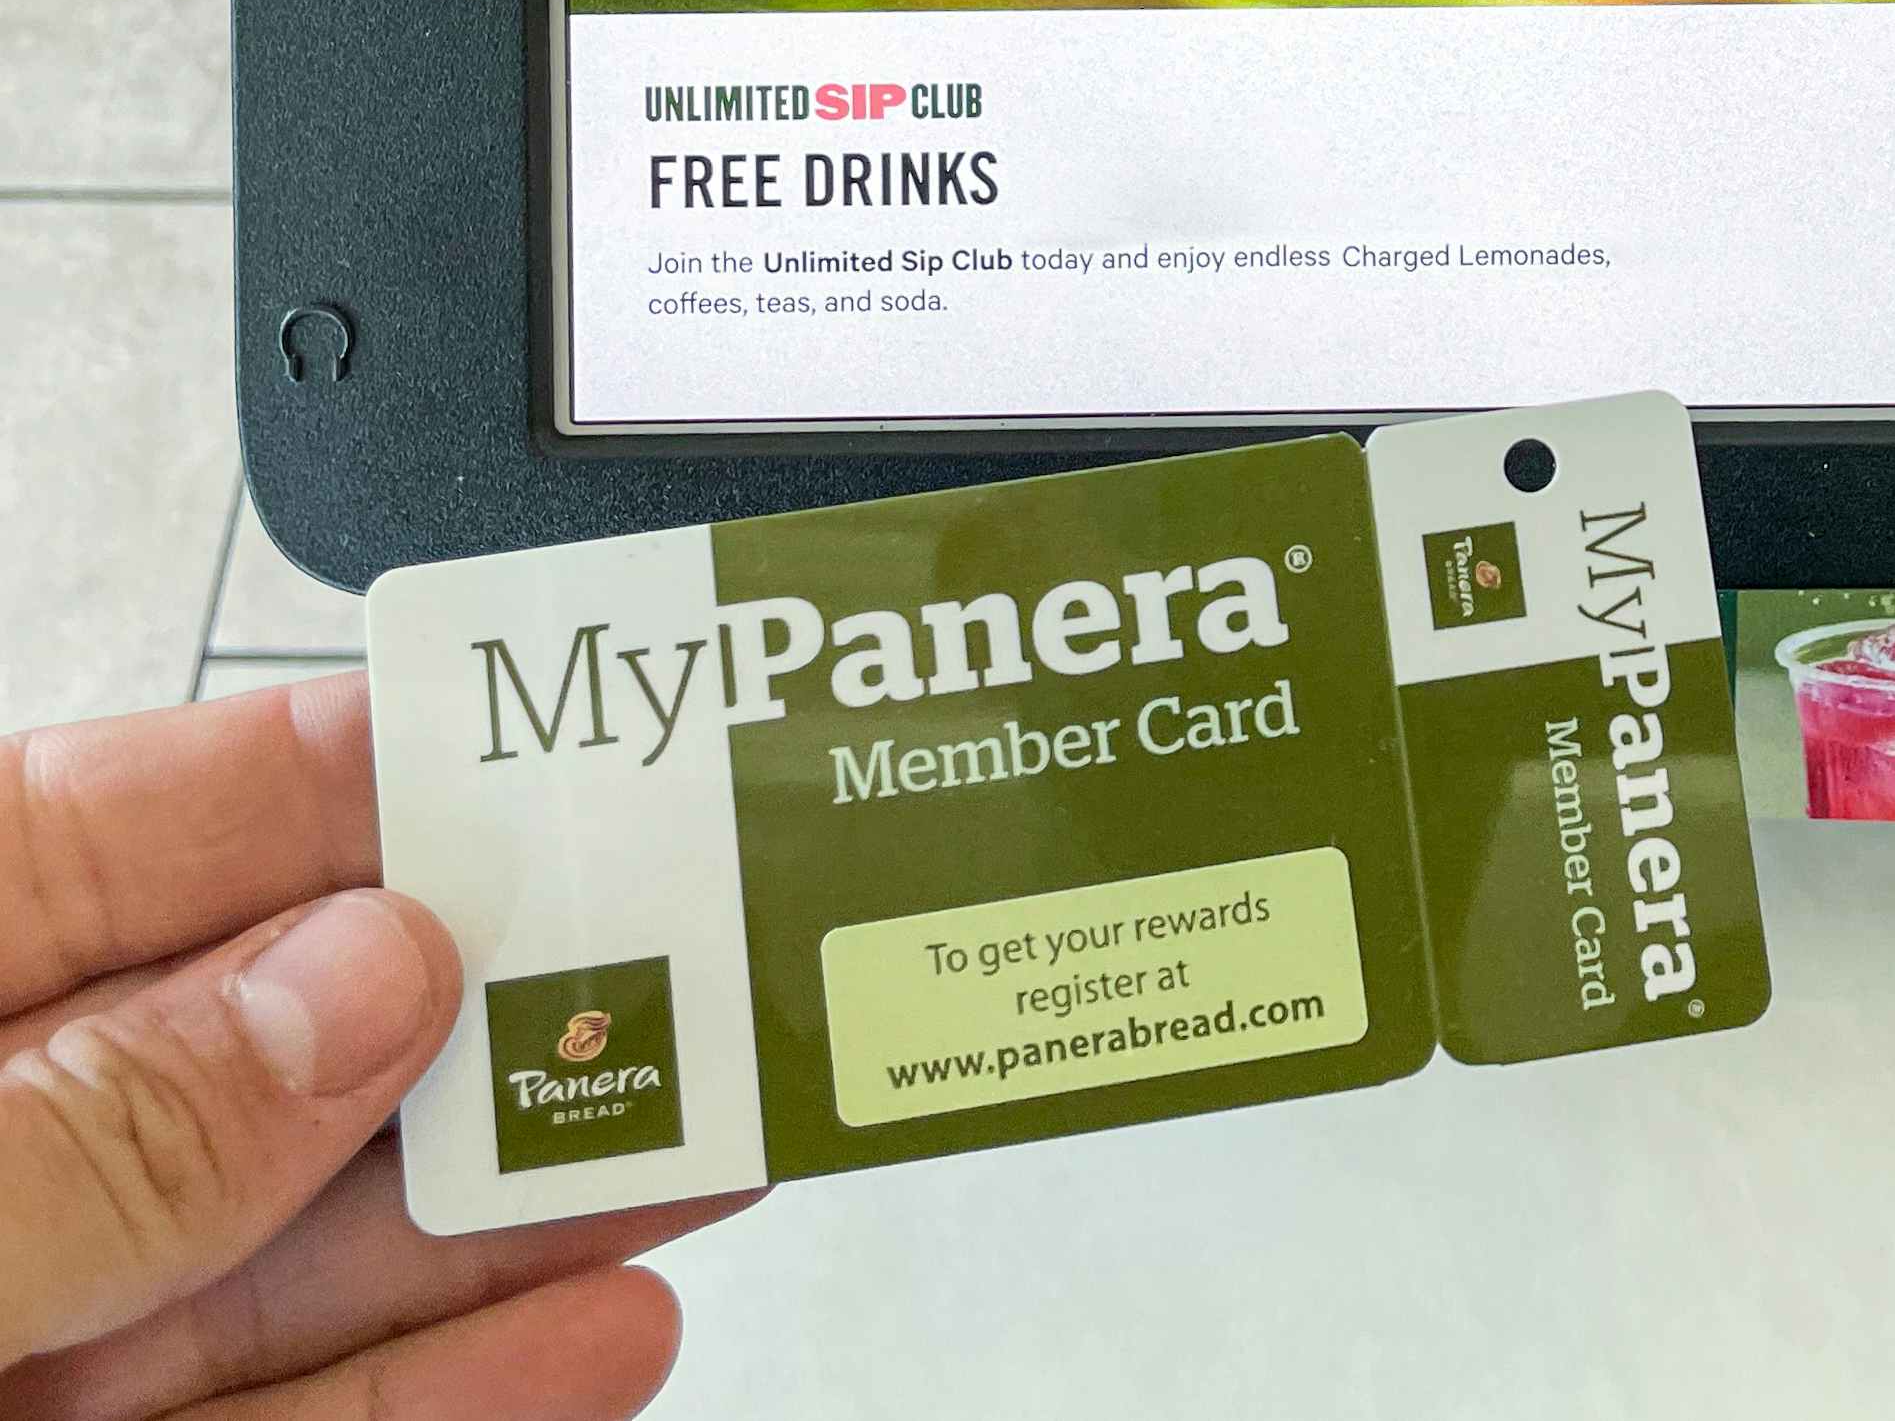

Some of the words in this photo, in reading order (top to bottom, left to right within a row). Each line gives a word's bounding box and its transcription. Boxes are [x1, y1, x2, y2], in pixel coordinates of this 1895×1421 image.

[645, 84, 810, 122] UNLIMITED
[815, 83, 907, 121] SIP
[911, 82, 983, 119] CLUB
[650, 153, 782, 208] FREE
[805, 151, 998, 207] DRINKS
[648, 252, 702, 274] Join
[712, 251, 753, 273] the
[764, 249, 892, 273] Unlimited
[901, 250, 943, 277] Sip
[952, 248, 1012, 272] Club
[1021, 248, 1093, 276] today
[1102, 243, 1148, 270] and
[1157, 245, 1226, 273] enjoy
[1234, 243, 1331, 268] endless
[1342, 244, 1450, 272] Charged
[1460, 243, 1611, 268] Lemonades,
[648, 291, 749, 316] coffees,
[757, 291, 817, 316] teas,
[824, 289, 871, 313] and
[881, 288, 948, 313] soda.
[830, 715, 1120, 806] Member
[1137, 681, 1301, 758] Card
[1545, 715, 1594, 897] Member
[1570, 905, 1616, 1011] Card
[925, 942, 969, 977] To
[979, 933, 1037, 976] get
[1046, 918, 1126, 966] your
[1134, 891, 1271, 941] rewards
[1015, 967, 1147, 1018] register
[1157, 959, 1191, 993] at
[887, 992, 1326, 1090] www.panerabread.com
[508, 1065, 662, 1108] Panera
[553, 1102, 625, 1125] BREAD
